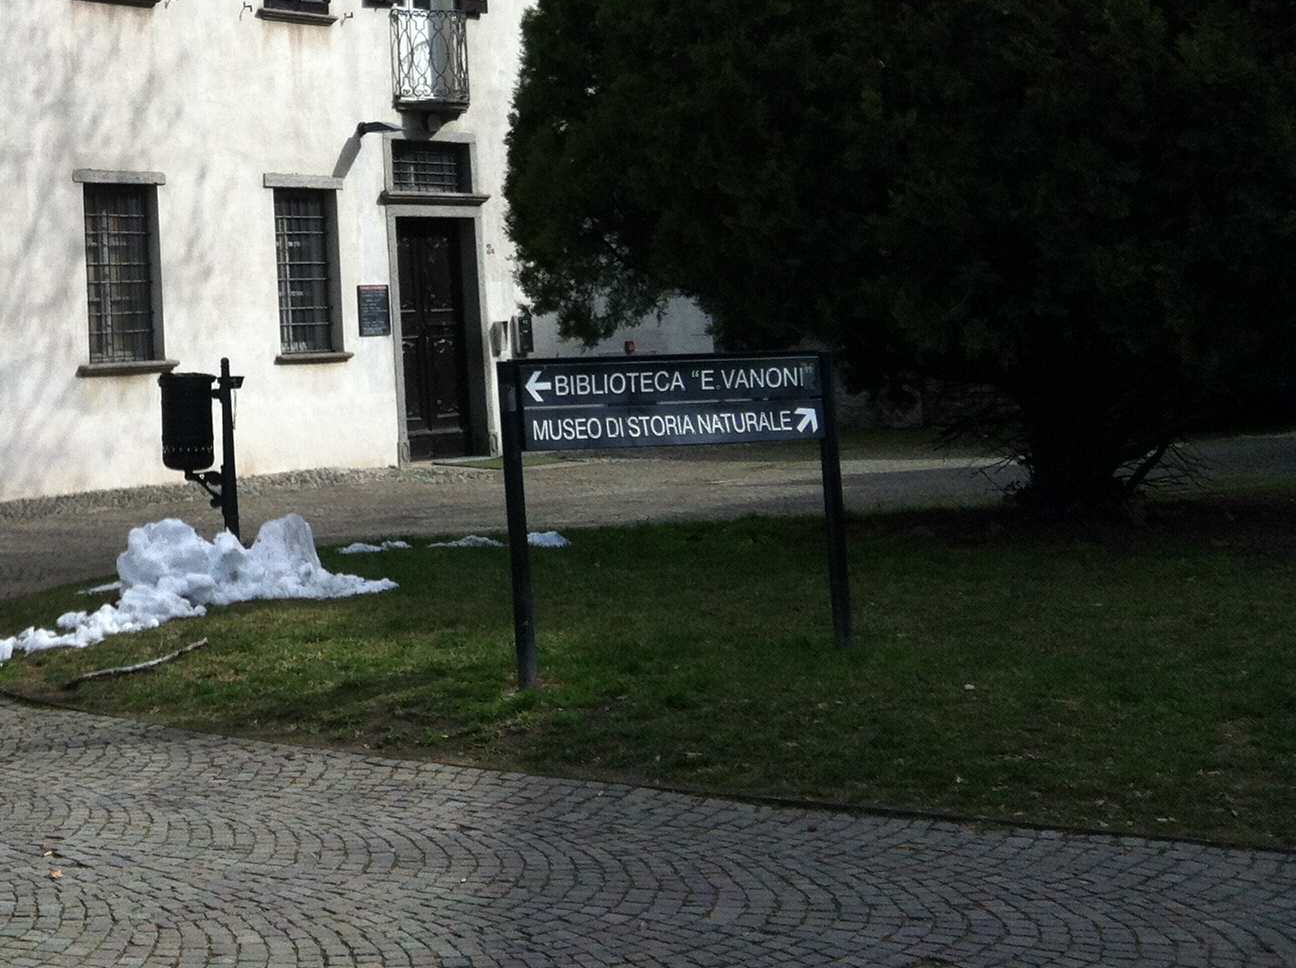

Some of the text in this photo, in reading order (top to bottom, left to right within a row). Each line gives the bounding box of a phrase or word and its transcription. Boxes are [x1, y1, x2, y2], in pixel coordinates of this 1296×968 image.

[555, 371, 686, 396] BIBLIOTECA
[532, 411, 793, 441] MUSEO DI STORIA NATURALE
